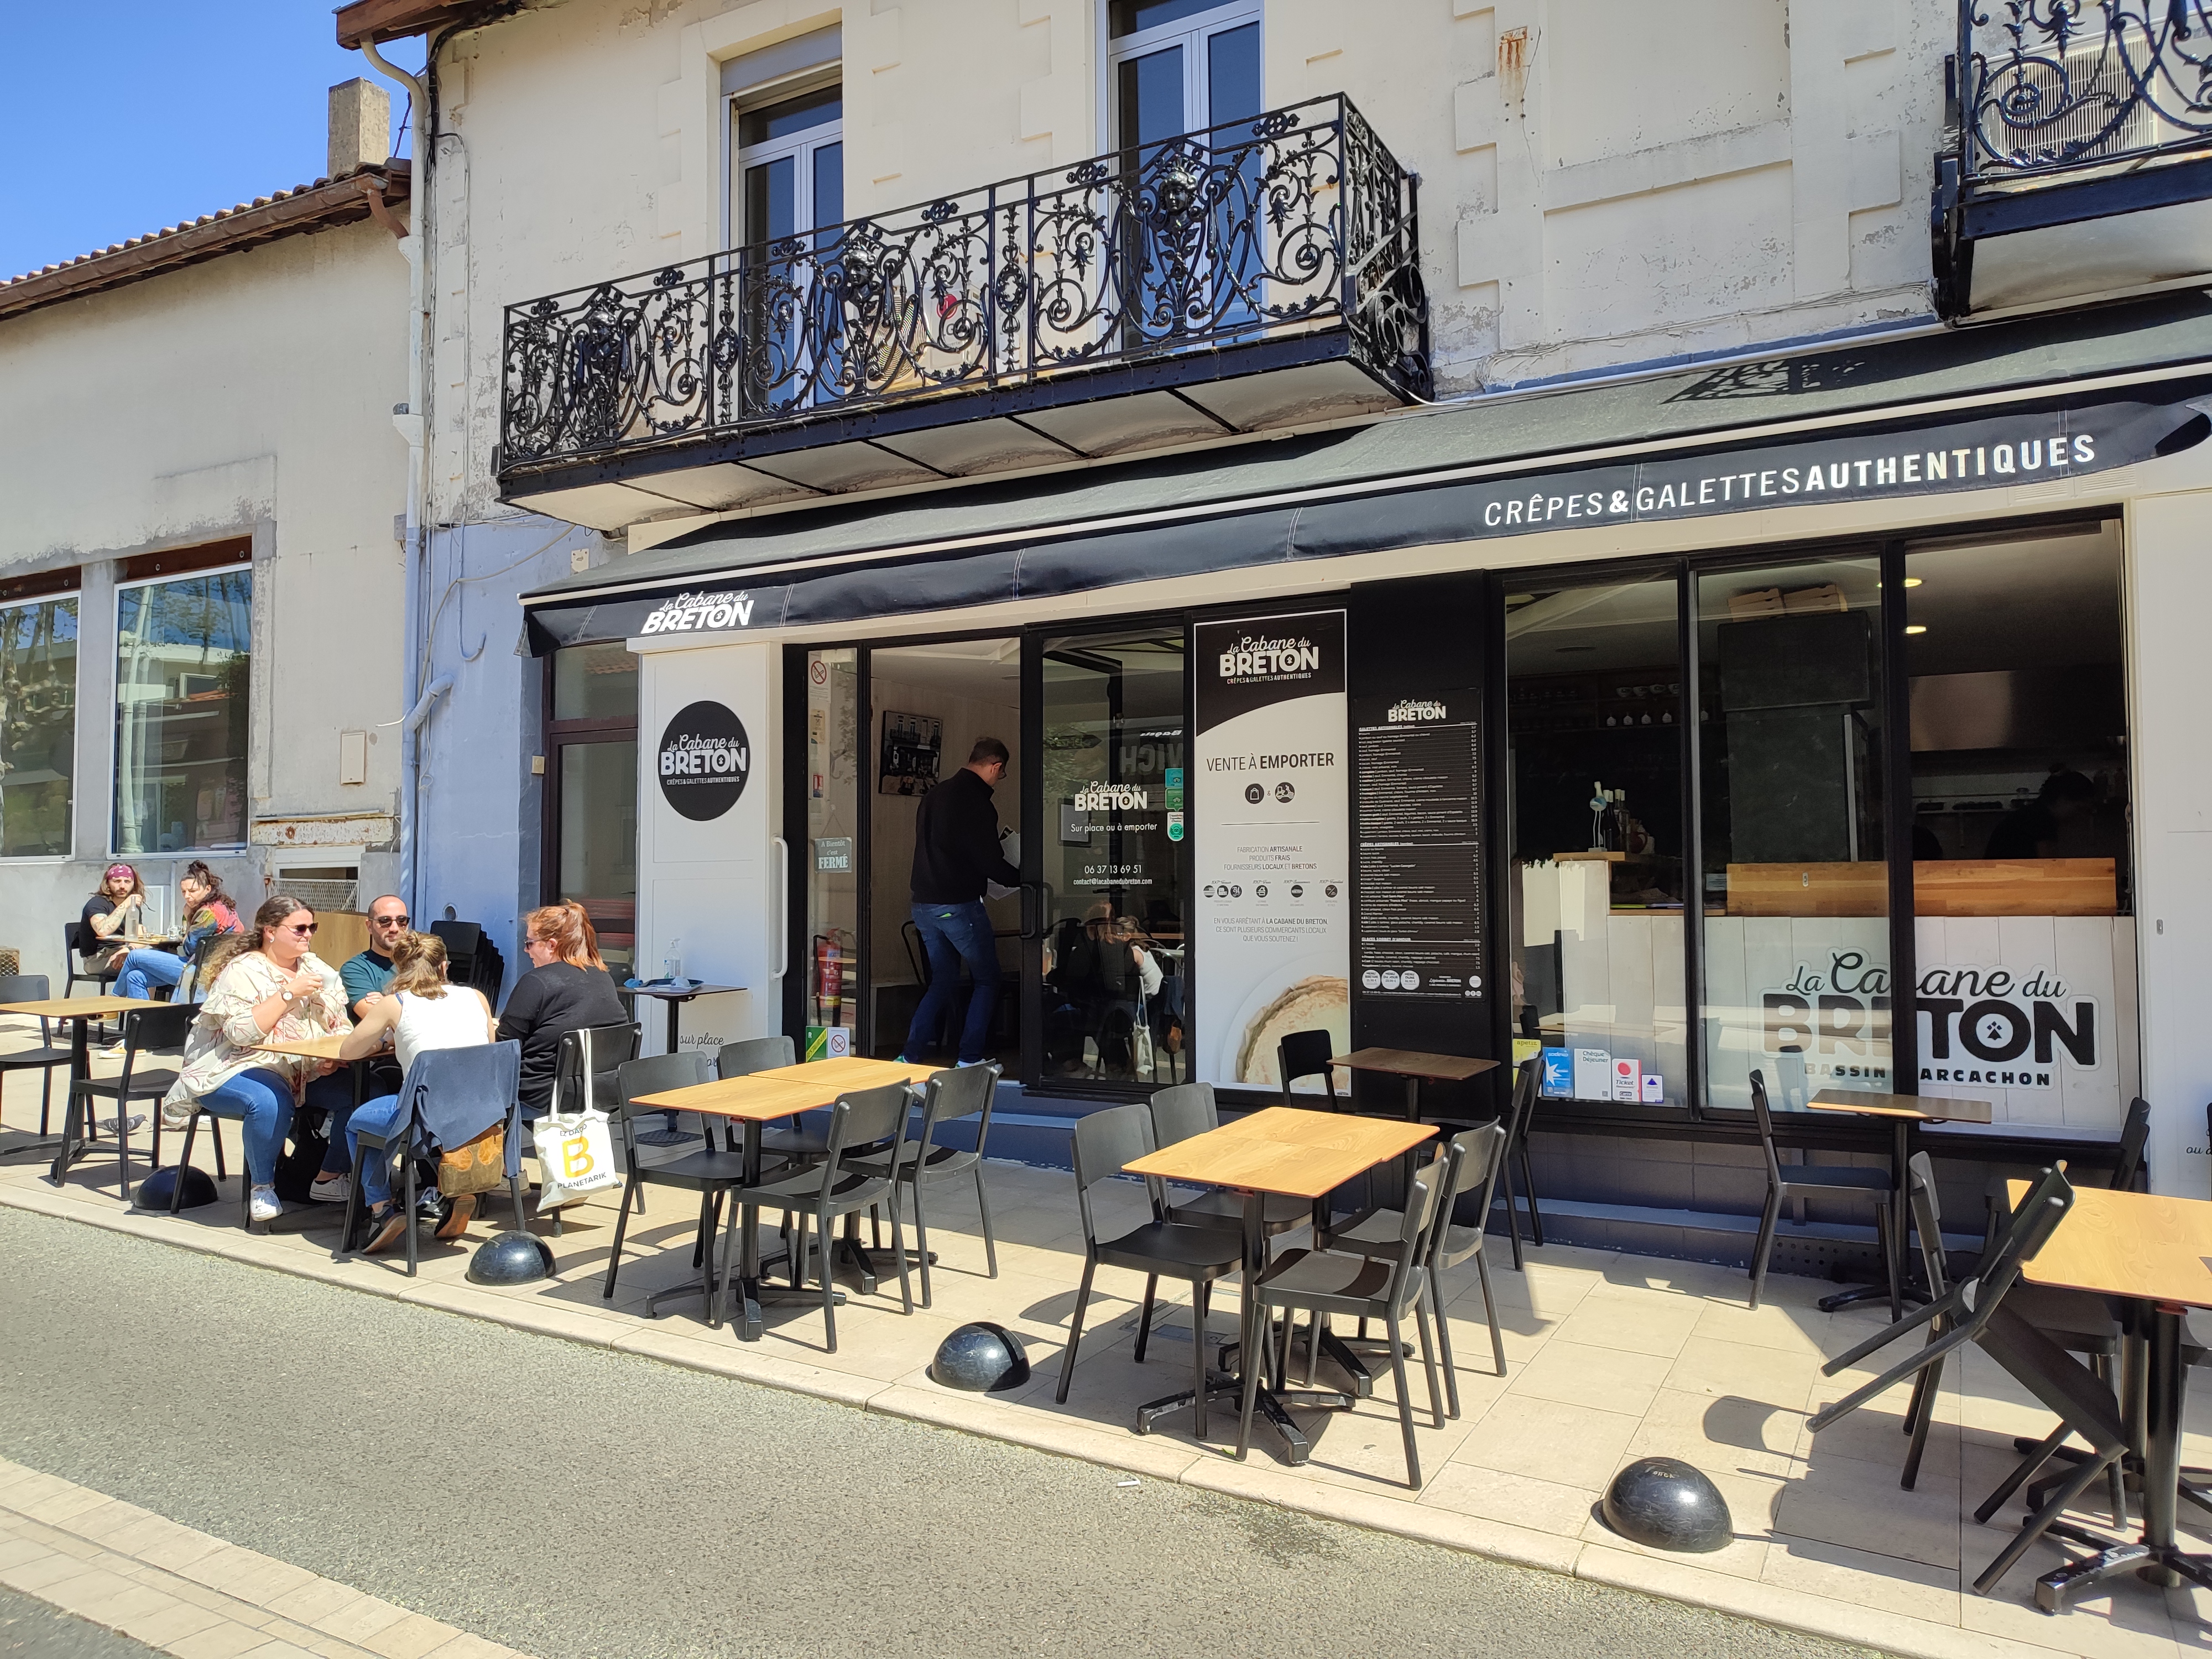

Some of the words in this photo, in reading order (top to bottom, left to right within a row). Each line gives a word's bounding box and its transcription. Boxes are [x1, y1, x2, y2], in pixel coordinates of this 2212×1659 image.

[659, 599, 674, 612] La
[674, 590, 734, 609] Cabane
[733, 591, 749, 602] du
[640, 599, 754, 634] BRETON
[1227, 643, 1240, 655] La
[1240, 635, 1297, 653] Cabane
[1297, 637, 1312, 648] du
[1219, 646, 1319, 677] BRETON
[1400, 699, 1433, 709] Cabane
[1388, 706, 1446, 722] BRETON
[667, 740, 679, 753] La
[679, 733, 727, 751] Cabane
[728, 737, 740, 748] du
[660, 748, 747, 775] BRETON
[1206, 757, 1246, 771] VENTE
[1248, 753, 1257, 770] À
[1260, 752, 1334, 769] EMPORTER
[1079, 785, 1089, 795] La
[1090, 780, 1131, 793] Cabane
[1131, 783, 1142, 791] du
[1074, 791, 1147, 811] BRETON
[1071, 823, 1082, 832] Sur
[1084, 823, 1104, 834] place
[1117, 823, 1122, 831] à
[1124, 823, 1157, 833] emporter
[818, 853, 848, 869] FERMÉ
[1084, 865, 1095, 874] 06
[1097, 865, 1107, 874] 37
[1109, 865, 1118, 874] 13
[1120, 865, 1131, 874] 69
[1133, 864, 1142, 874] 51
[1235, 916, 1261, 925] ARRÊTANT
[1786, 966, 1825, 995] La
[1831, 952, 2015, 997] Caane
[2022, 971, 2066, 998] du
[680, 1034, 696, 1045] sur
[696, 1032, 724, 1050] place
[1804, 1063, 1886, 1078] BASSIN
[562, 1136, 594, 1178] B
[557, 1171, 607, 1189] PLANETARIK
